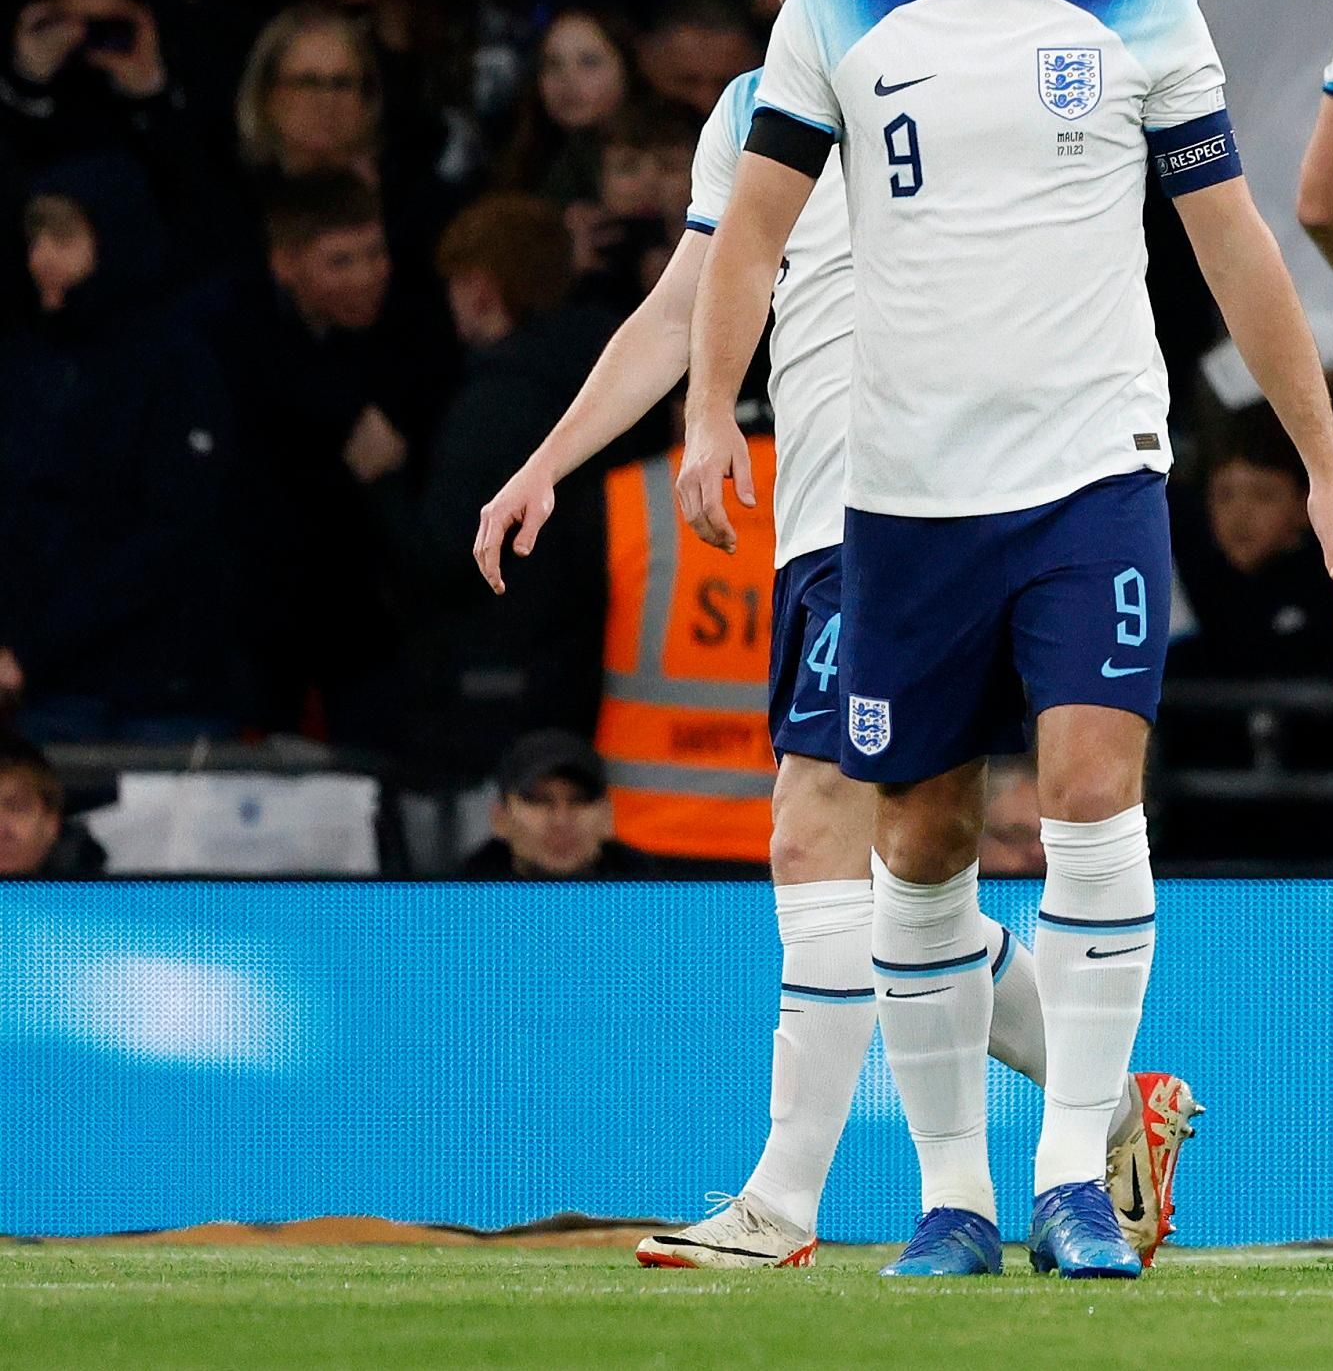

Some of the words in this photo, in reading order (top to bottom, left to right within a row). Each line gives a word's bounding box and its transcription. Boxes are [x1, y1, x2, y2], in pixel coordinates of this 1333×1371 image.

[883, 113, 923, 198] 9
[1057, 131, 1084, 143] MALTA
[1170, 138, 1227, 170] RESPECT
[1113, 567, 1147, 647] 9
[806, 611, 841, 693] 4
